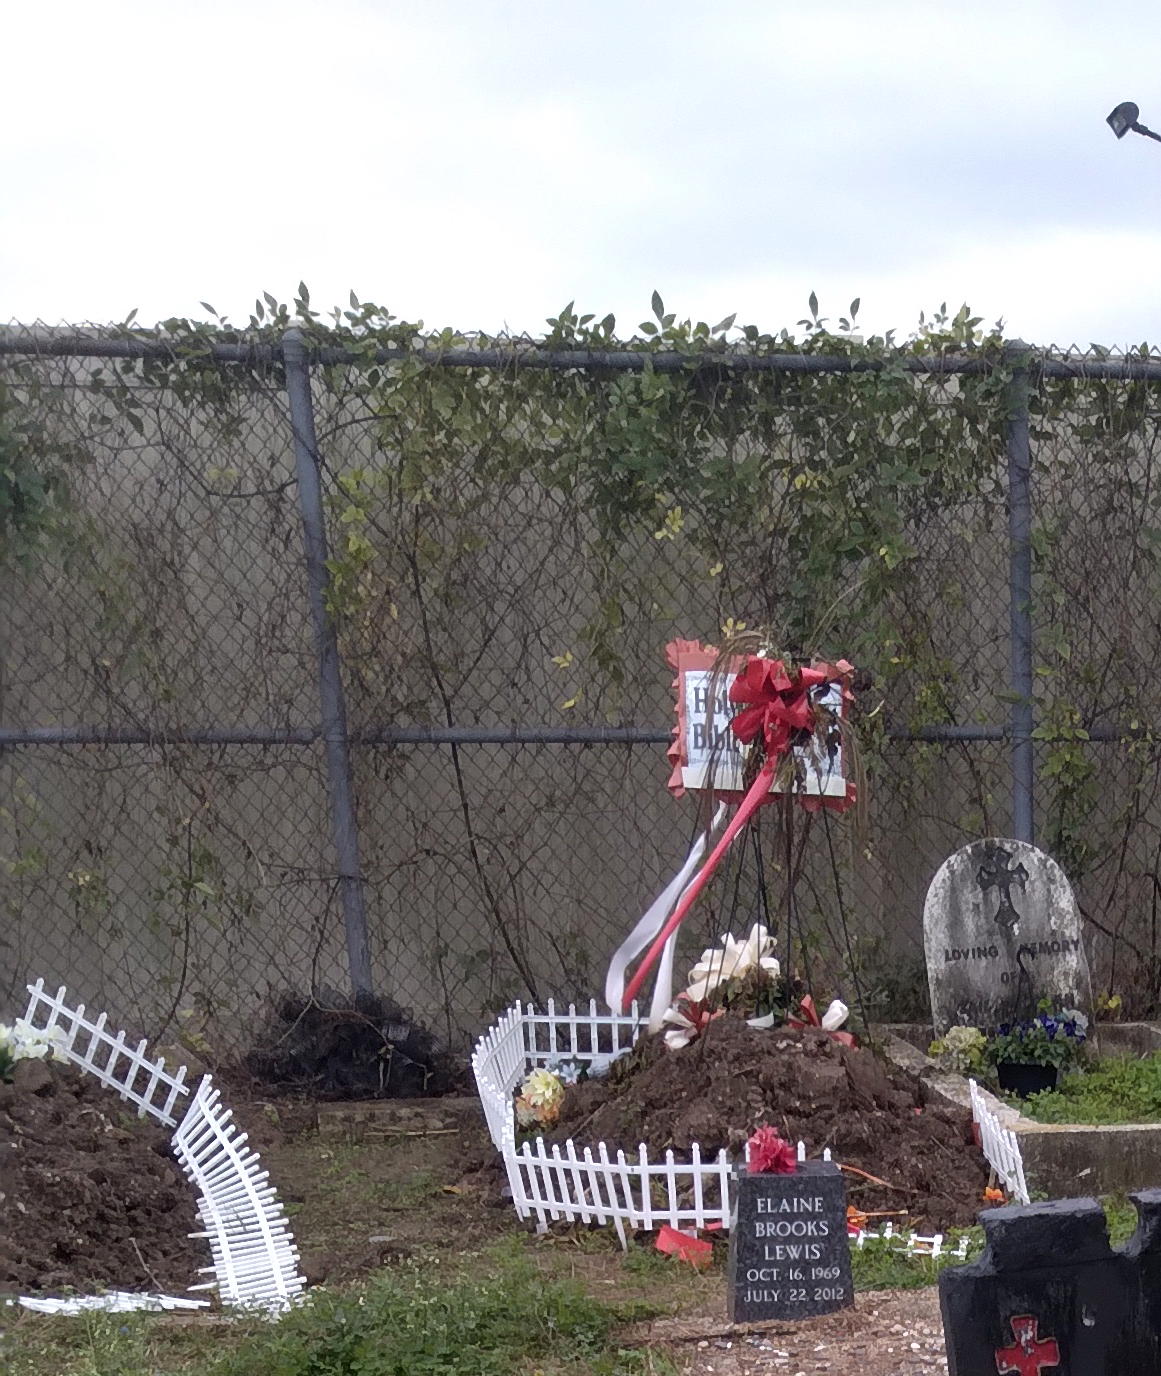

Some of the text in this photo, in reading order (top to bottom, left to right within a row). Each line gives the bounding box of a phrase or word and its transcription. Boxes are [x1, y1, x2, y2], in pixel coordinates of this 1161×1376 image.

[945, 945, 999, 962] LOVING
[757, 1197, 824, 1213] ELAINE
[755, 1220, 829, 1237] BROOKS
[764, 1244, 821, 1260] LEWIS
[811, 1266, 840, 1280] 1969
[743, 1289, 781, 1303] JULY
[814, 1287, 844, 1300] 2012
